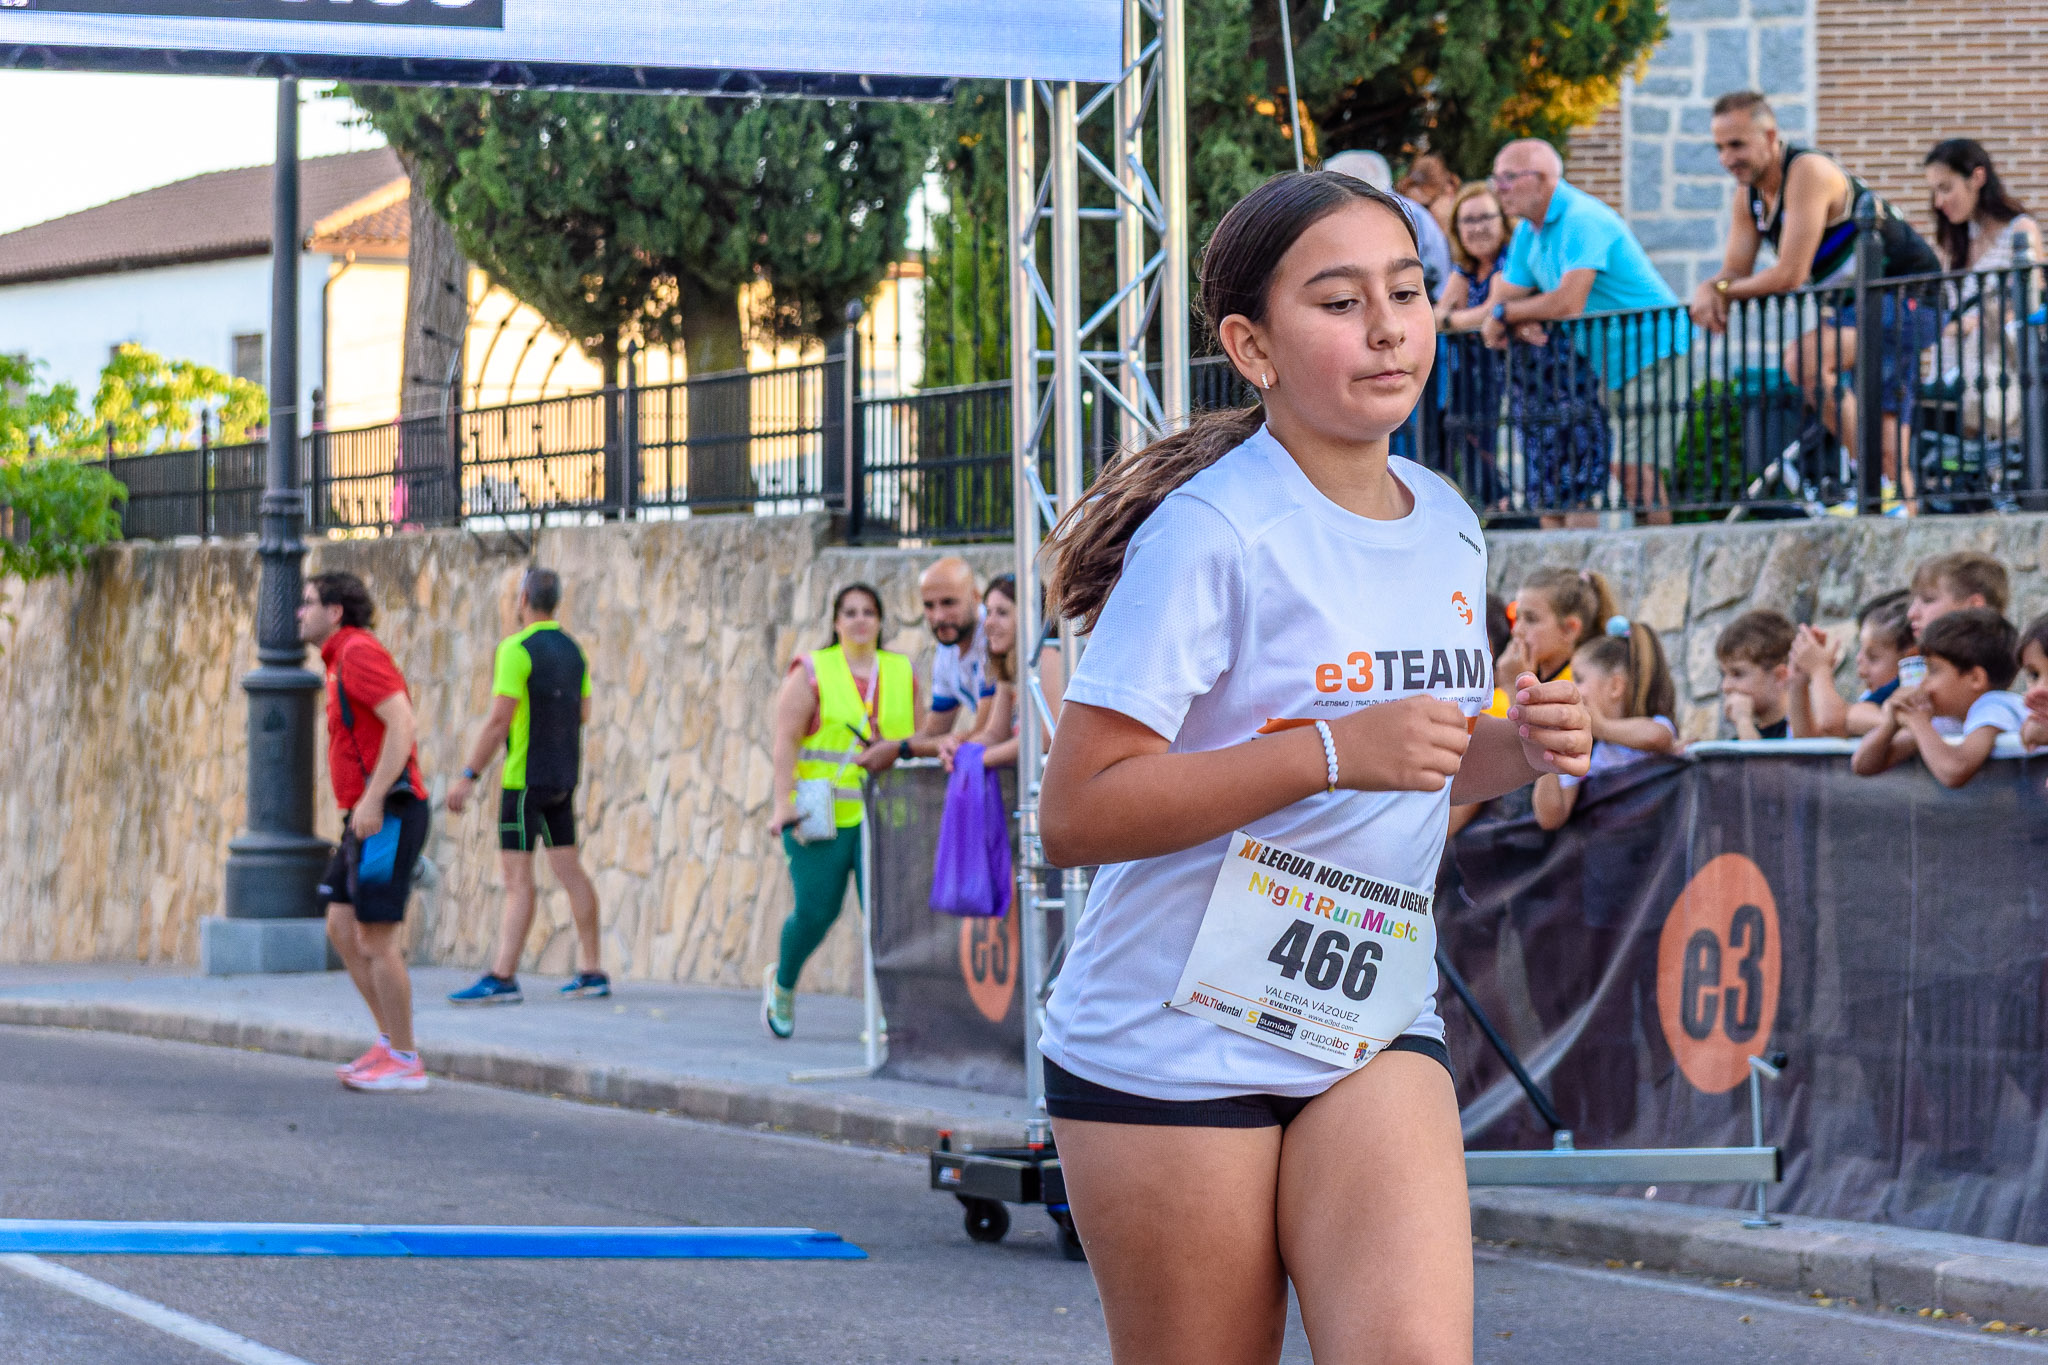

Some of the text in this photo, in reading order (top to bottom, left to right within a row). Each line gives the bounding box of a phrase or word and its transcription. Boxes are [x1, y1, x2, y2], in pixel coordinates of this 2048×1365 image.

[1315, 649, 1486, 693] e3TEAM
[1258, 846, 1317, 881] LEGUA
[1314, 866, 1400, 908] NOCTURNA
[1399, 890, 1428, 916] UGENA
[1267, 919, 1384, 1001] 466
[1681, 903, 1765, 1044] e3
[1190, 991, 1243, 1018] MULTIdental
[1265, 985, 1360, 1023] VALERIA VÁZQUEZ
[1269, 999, 1302, 1016] EVENTOS
[1308, 1013, 1354, 1032] www.e3pd.com
[1300, 1028, 1350, 1051] grupoibc
